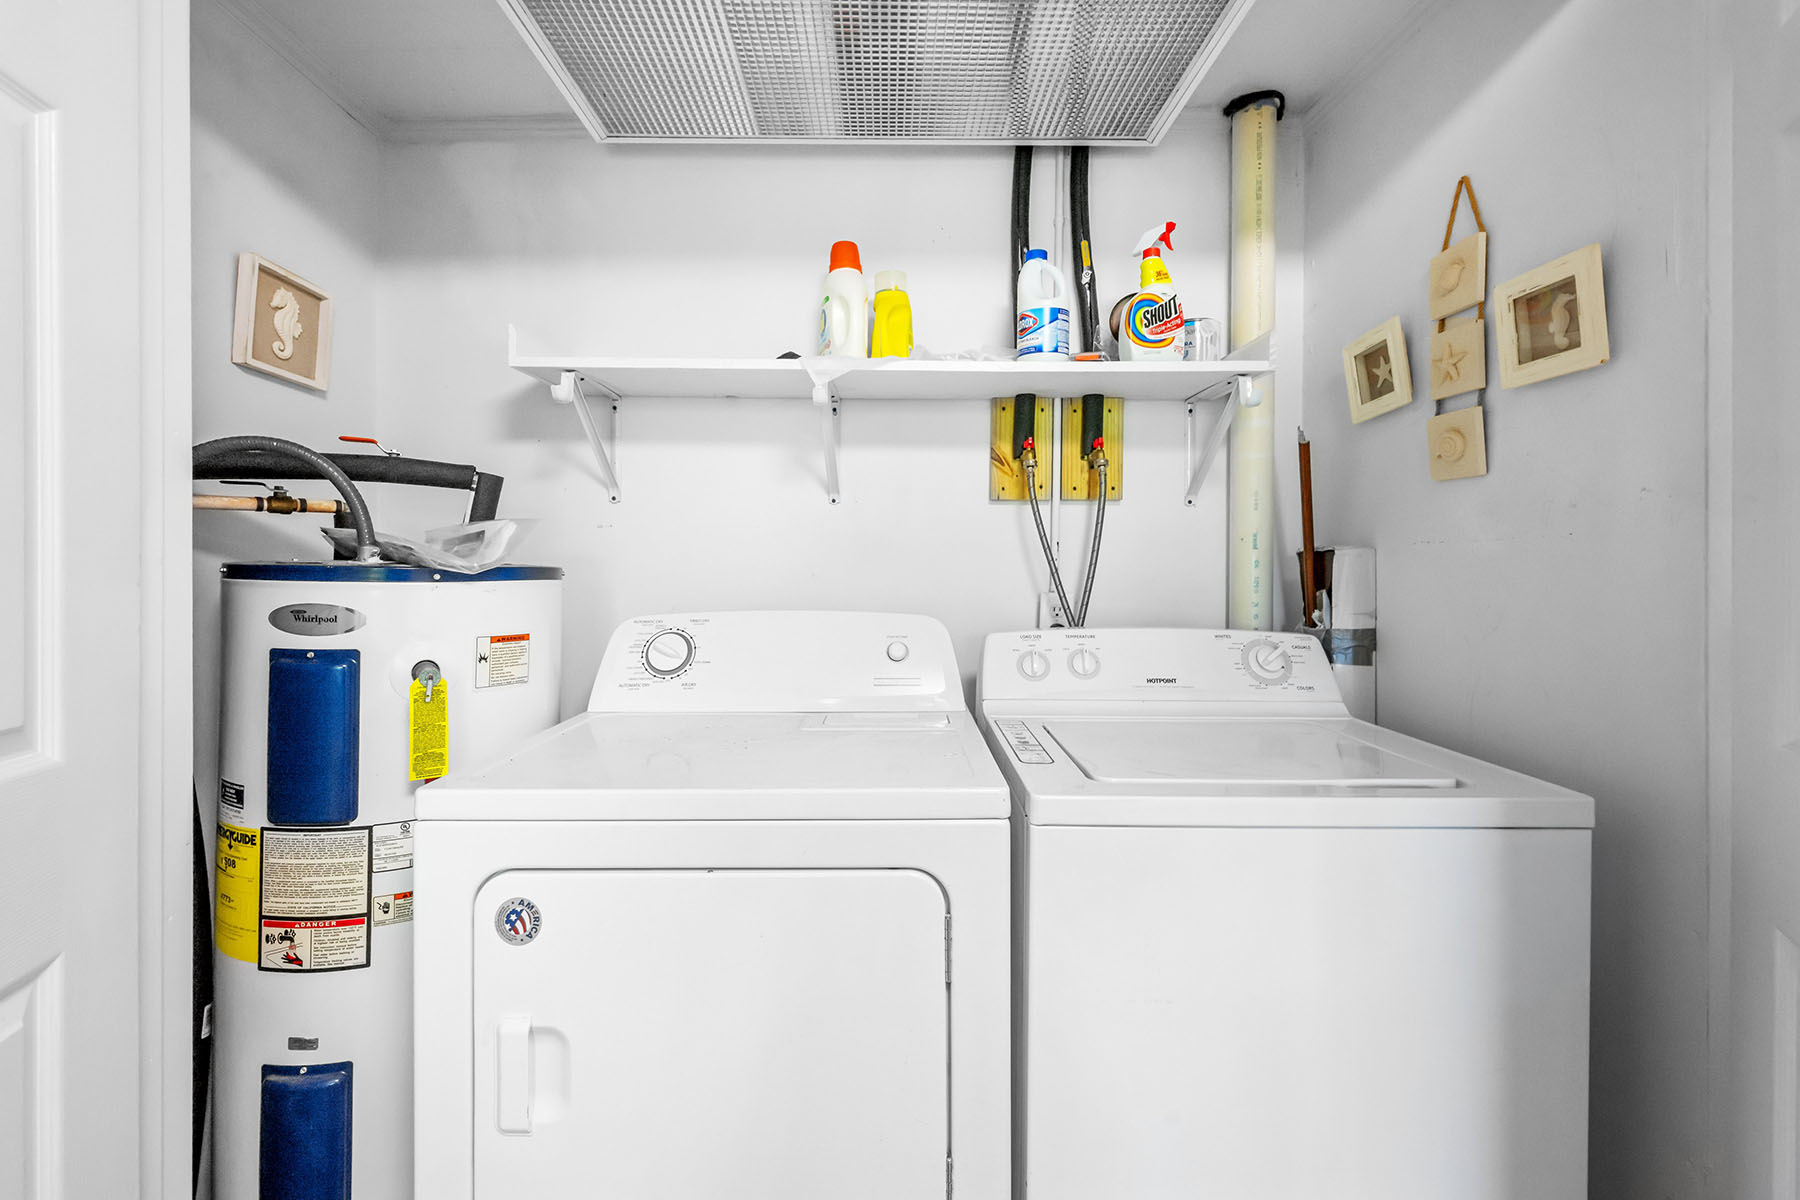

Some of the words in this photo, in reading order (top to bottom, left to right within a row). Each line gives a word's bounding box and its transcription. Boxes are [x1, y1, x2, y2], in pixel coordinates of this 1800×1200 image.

[1143, 294, 1178, 328] SHOUT
[293, 614, 338, 625] Whirlpool
[518, 899, 540, 939] AMERICA
